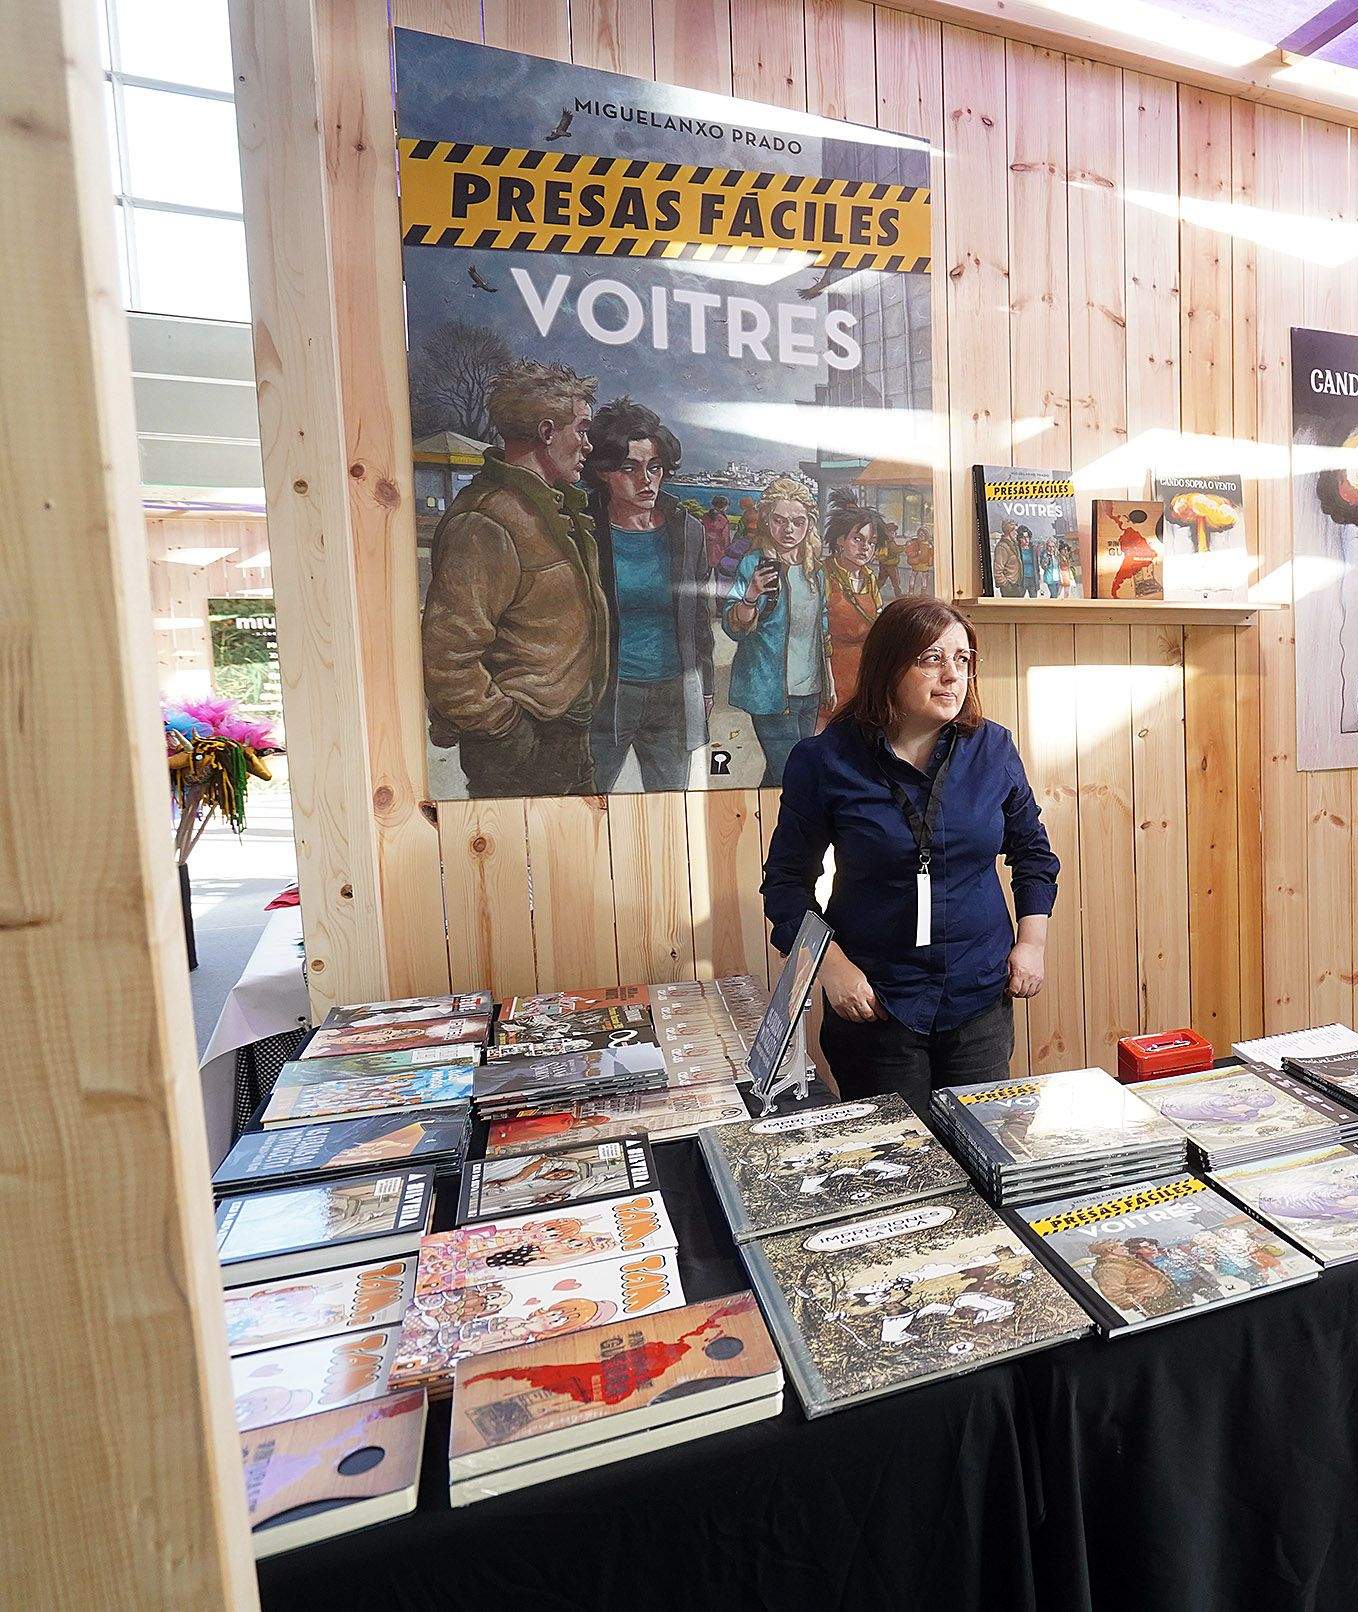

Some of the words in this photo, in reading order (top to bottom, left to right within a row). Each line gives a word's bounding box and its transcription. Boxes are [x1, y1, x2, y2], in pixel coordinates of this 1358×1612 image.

[573, 97, 725, 140] MIGUELANXO
[731, 128, 803, 156] PRADO
[451, 172, 681, 232] PRESAS
[698, 192, 900, 247] FÁCILES
[509, 267, 862, 372] VOITRES
[994, 485, 1031, 496] PRESAS
[1160, 478, 1185, 487] CANDO
[1185, 479, 1208, 490] SOPRA
[1215, 481, 1237, 492] VENTO
[1003, 502, 1064, 518] VOITRES
[974, 1086, 1037, 1100] PRESAS
[819, 1210, 941, 1244] IMPRESIONES
[1050, 1204, 1121, 1229] PRESAS
[1076, 1201, 1203, 1238] VOITRES
[839, 1236, 863, 1245] DE
[865, 1231, 886, 1239] LA
[888, 1219, 928, 1233] ISLA
